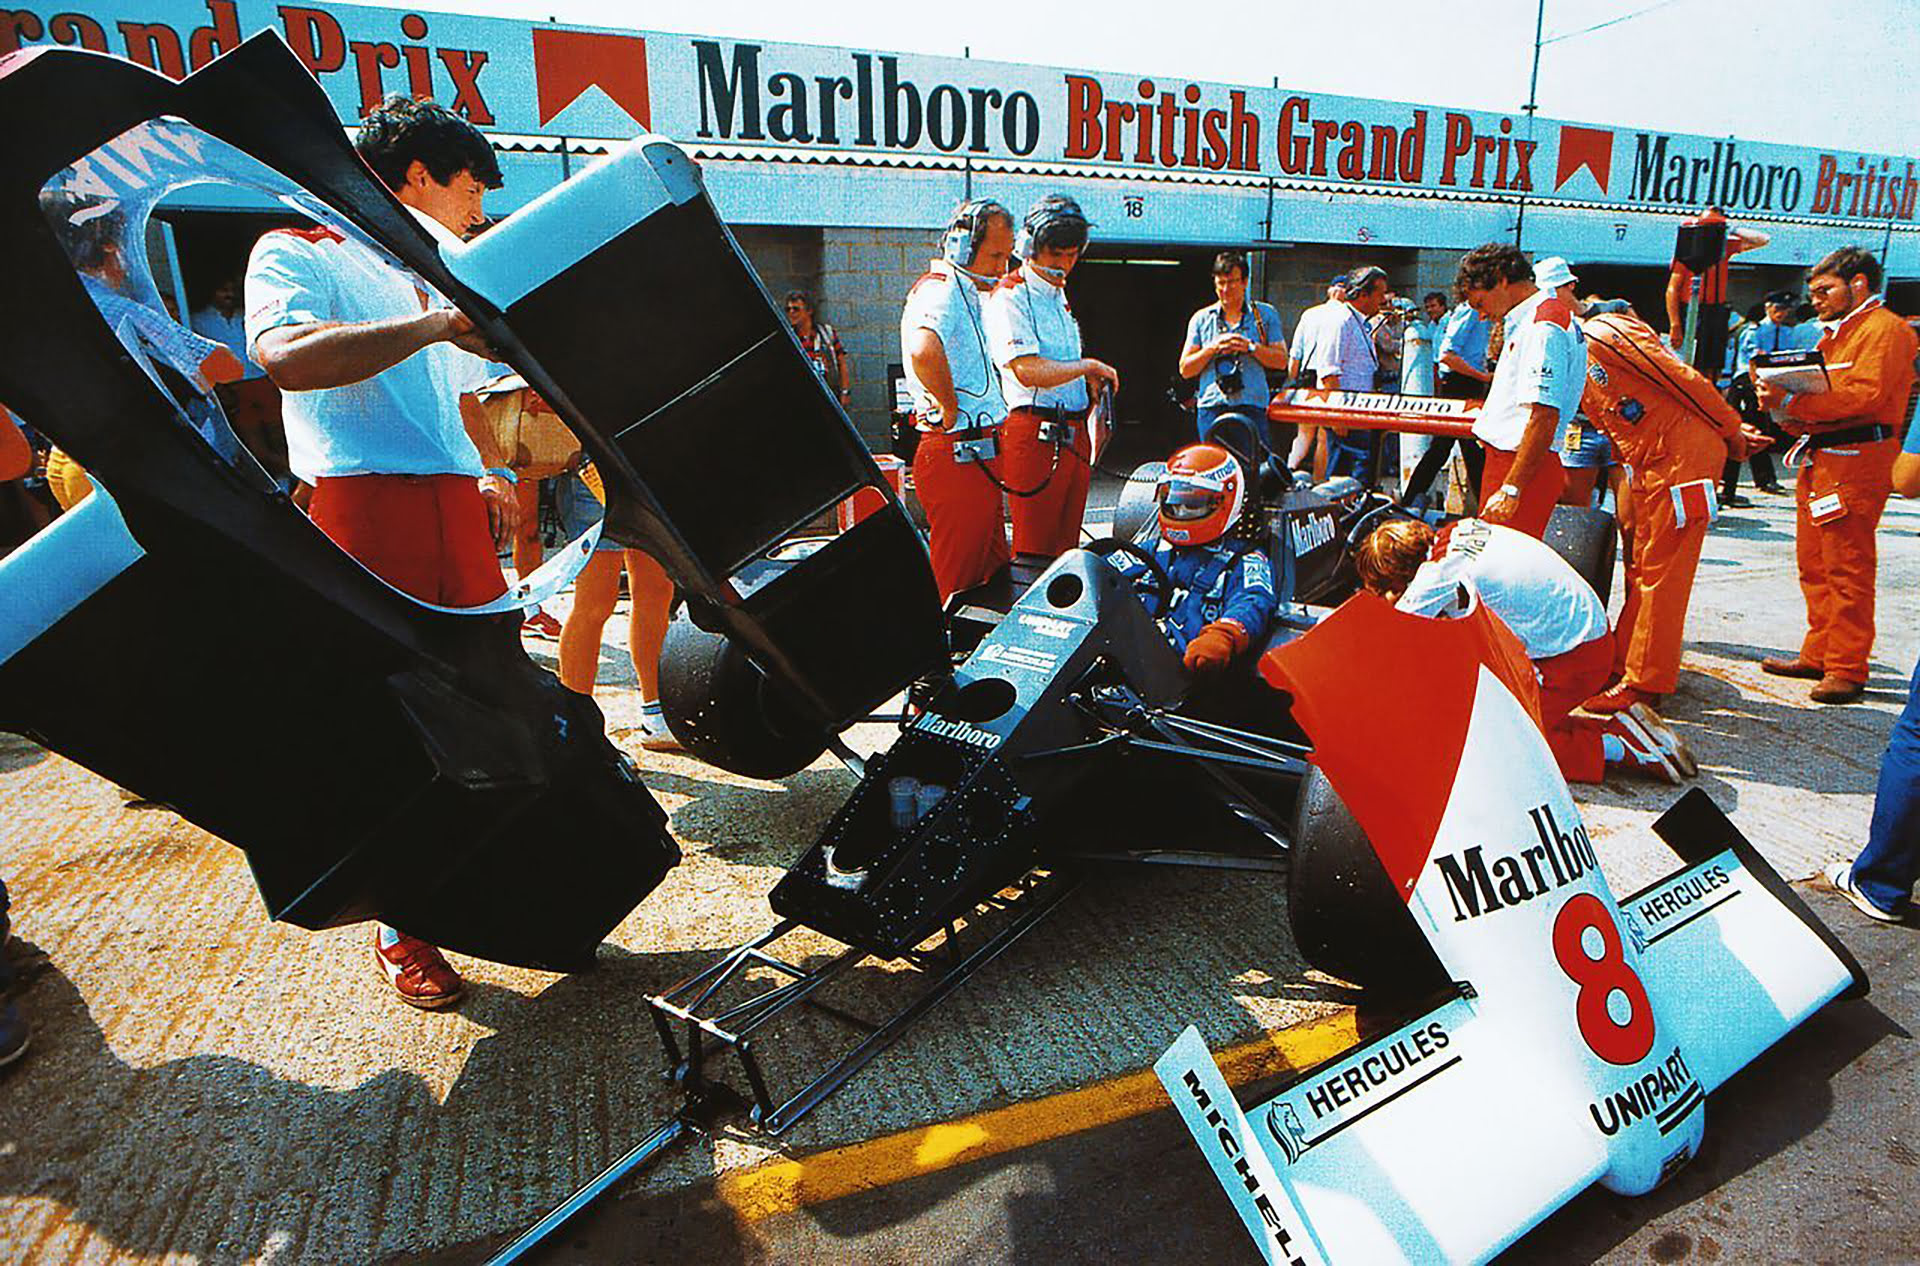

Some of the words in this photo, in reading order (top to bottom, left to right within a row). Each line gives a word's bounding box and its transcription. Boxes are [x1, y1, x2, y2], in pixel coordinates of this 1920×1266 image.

[278, 4, 496, 126] Prix
[691, 40, 1040, 156] Marlboro
[1063, 74, 1262, 173] British
[1277, 96, 1429, 184] Grand
[1439, 112, 1539, 192] Prix
[1124, 200, 1143, 218] 18
[1628, 133, 1802, 213] Marlboro
[1810, 153, 1918, 220] British
[1341, 391, 1452, 413] Marlboro
[1291, 512, 1336, 557] Marlboro
[914, 711, 1001, 749] Marlboro
[1433, 804, 1598, 923] Marlbo
[1640, 865, 1730, 926] HERCULES
[1552, 892, 1656, 1066] 8
[1306, 1022, 1450, 1120] HERCULES
[1590, 1046, 1691, 1136] UNIPART
